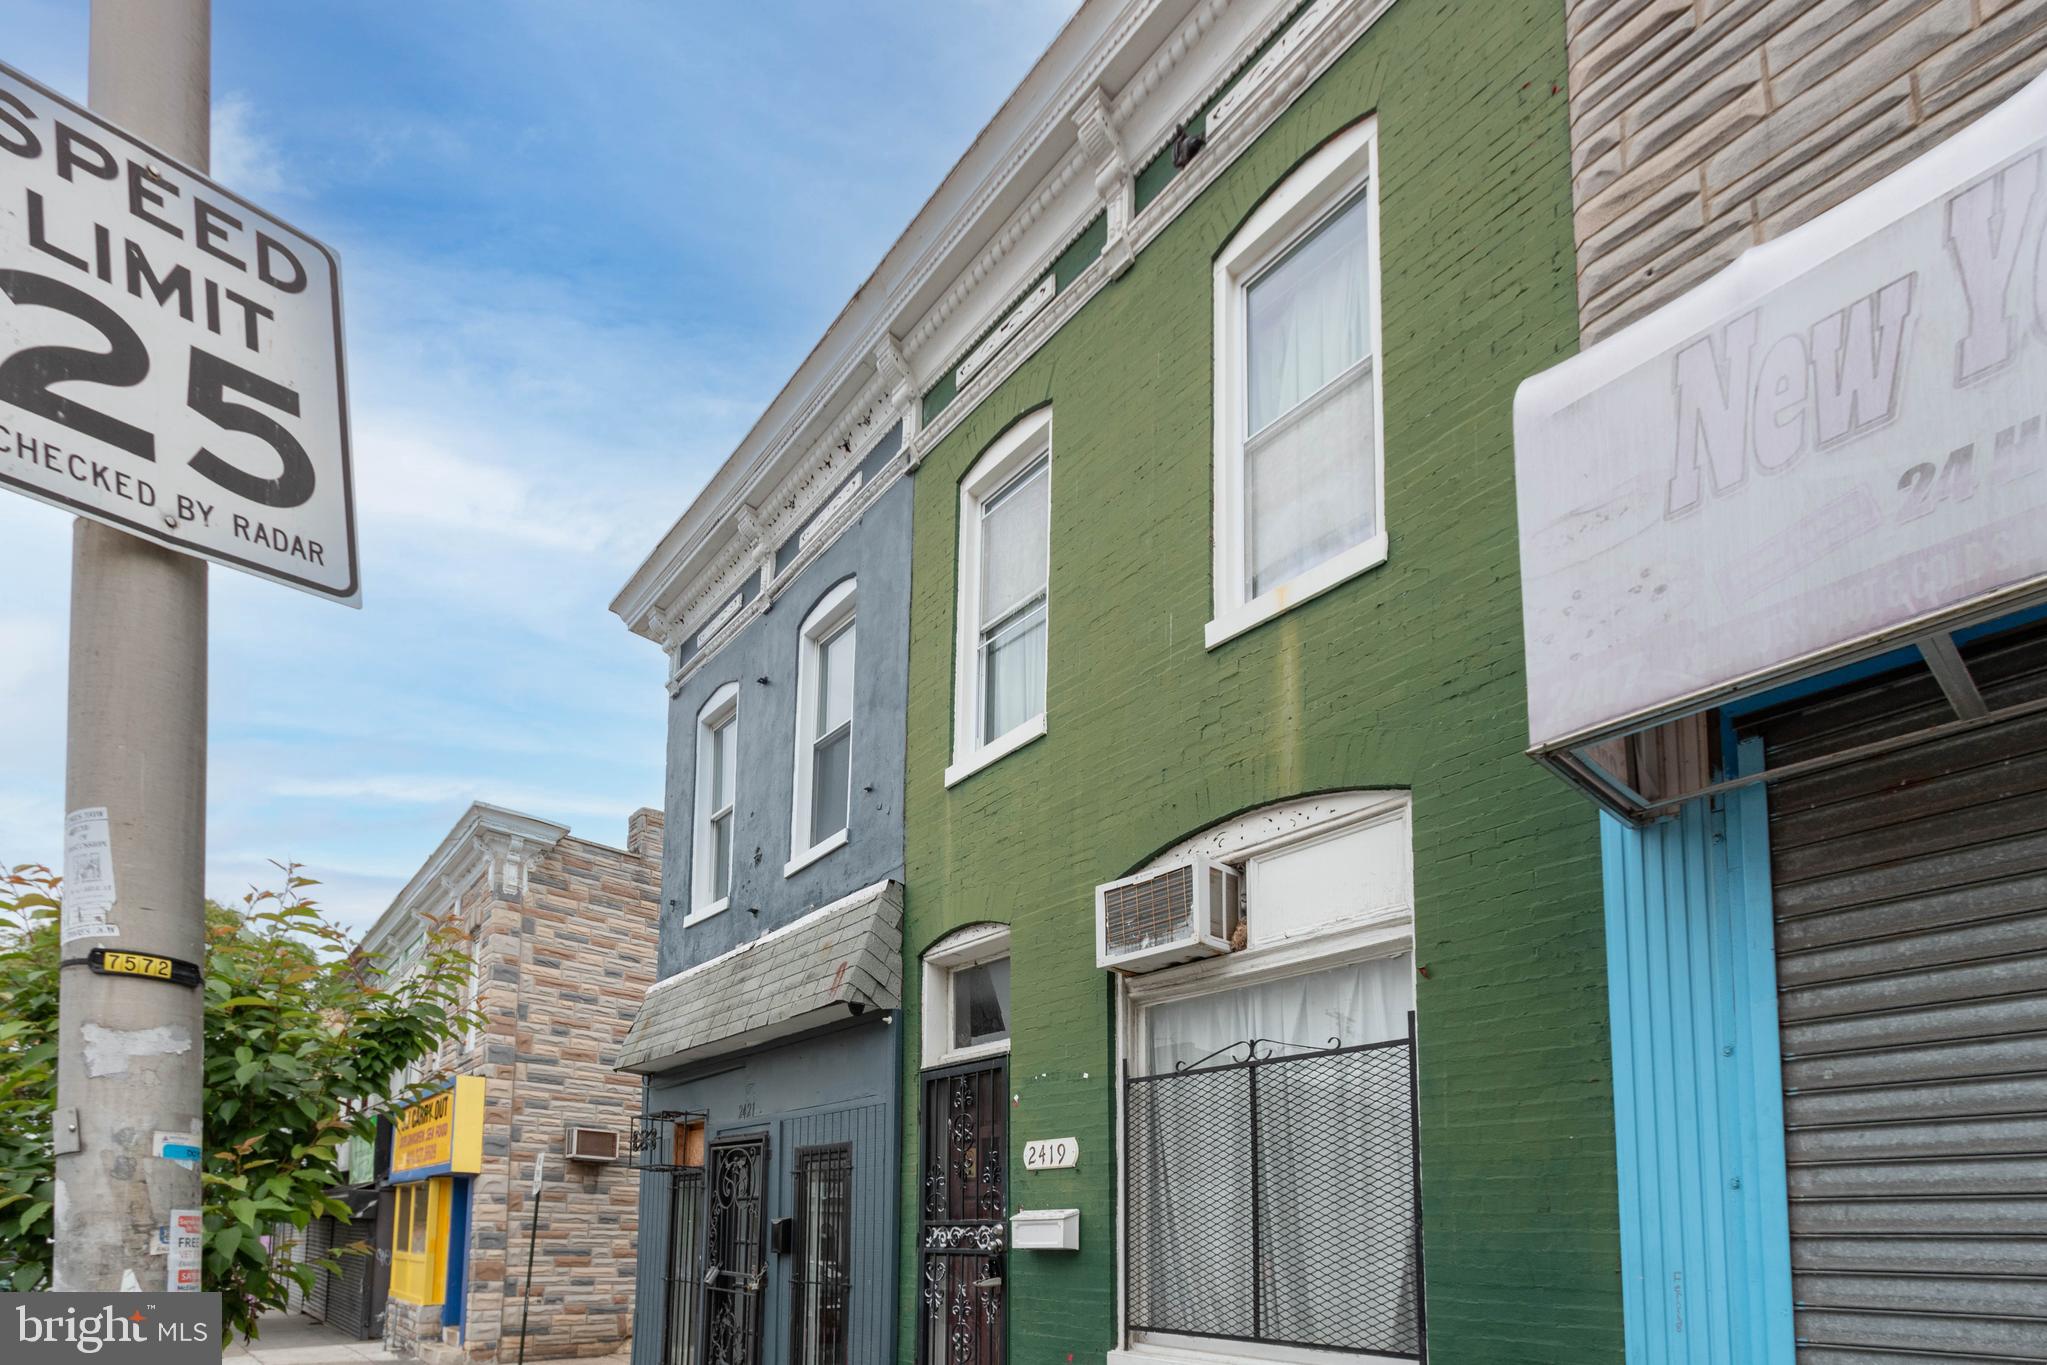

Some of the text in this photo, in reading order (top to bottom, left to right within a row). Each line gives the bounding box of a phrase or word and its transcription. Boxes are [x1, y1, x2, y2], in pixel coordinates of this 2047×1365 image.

[0, 88, 307, 295] SPEED
[26, 188, 275, 353] LIMIT
[0, 268, 316, 509] 25
[1664, 271, 1918, 522] New
[1896, 442, 1978, 527] 24
[177, 494, 214, 526] BY
[233, 514, 325, 567] RADAR
[109, 954, 168, 976] 7572
[434, 1096, 449, 1120] OUT
[1028, 1143, 1066, 1166] 2419
[178, 1237, 200, 1248] FREE
